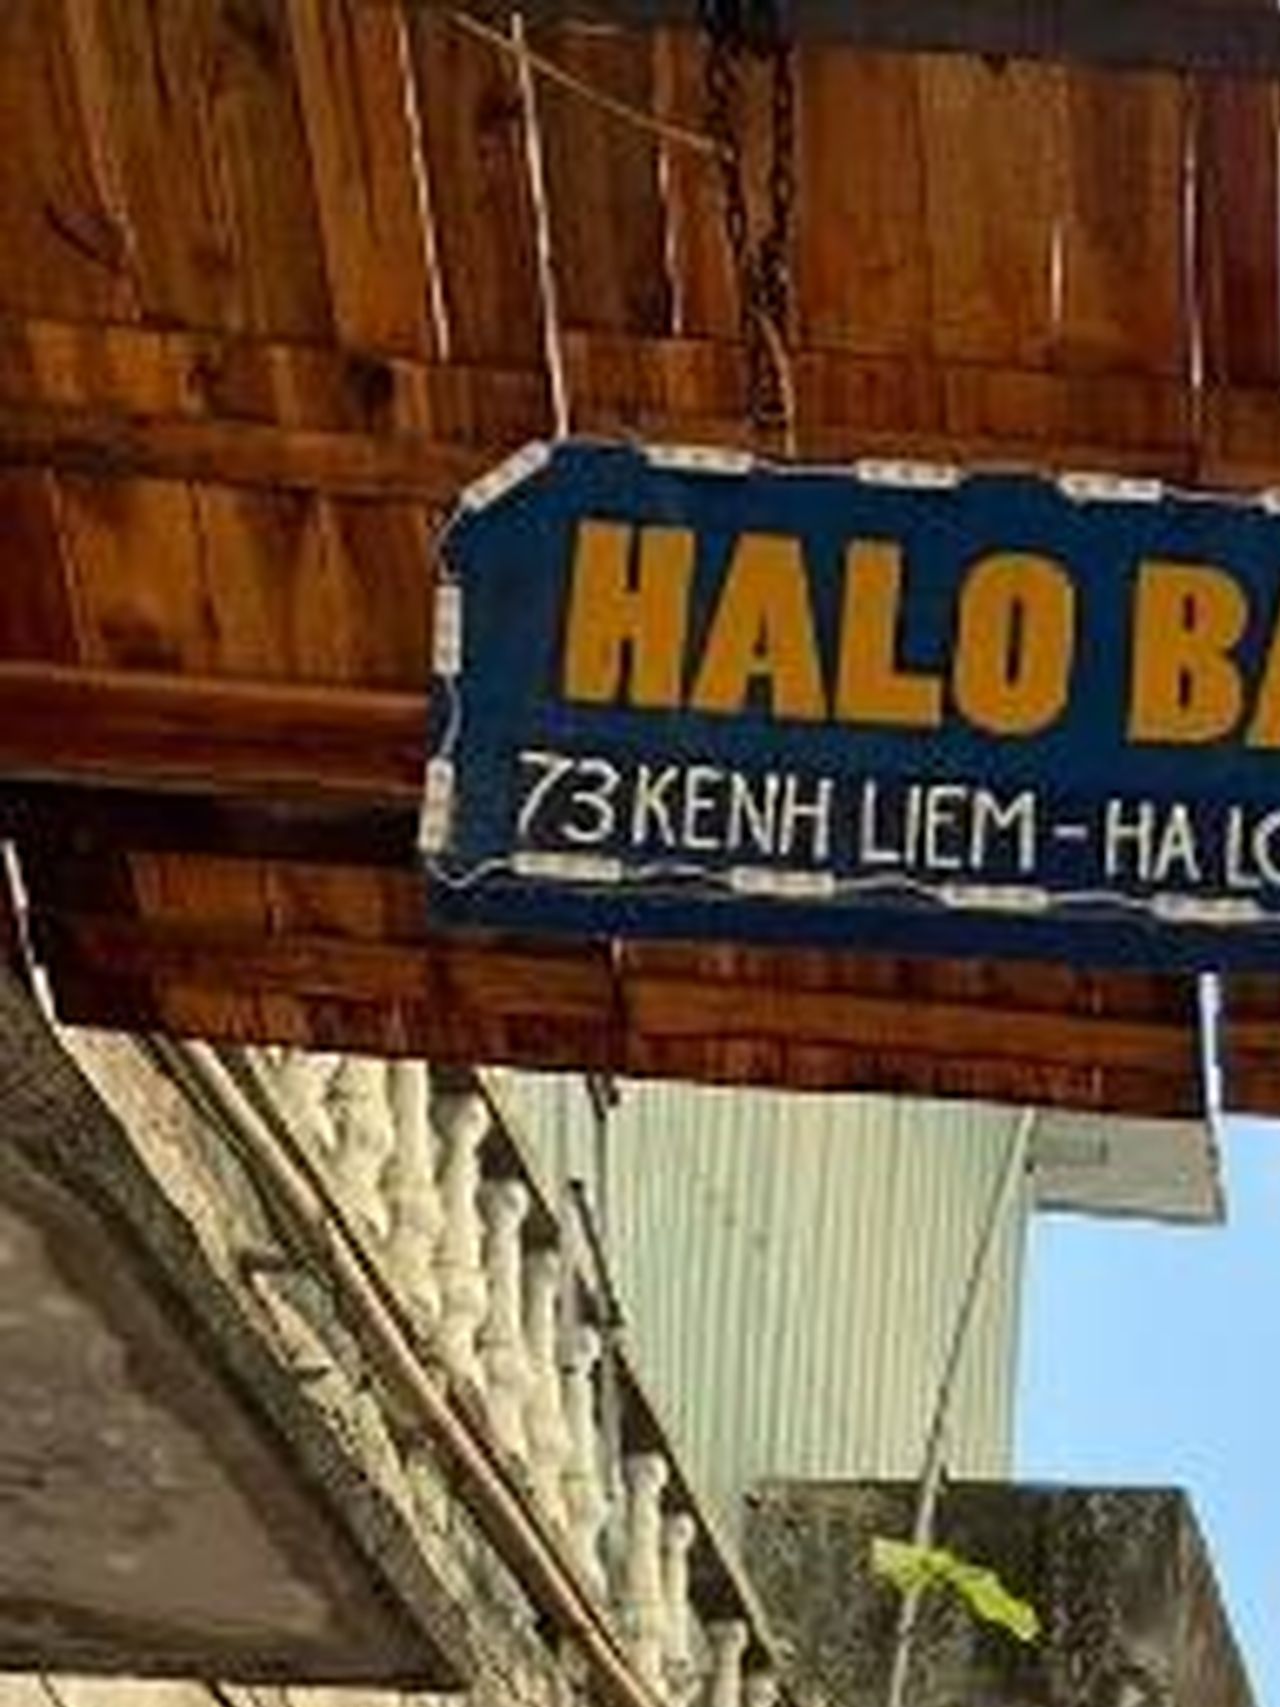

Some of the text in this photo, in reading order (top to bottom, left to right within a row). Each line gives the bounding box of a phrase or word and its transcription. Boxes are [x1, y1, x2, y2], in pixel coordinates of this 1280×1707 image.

[566, 521, 1074, 734] HALO
[860, 780, 1036, 870] LIEM
[1105, 800, 1200, 882] HA
